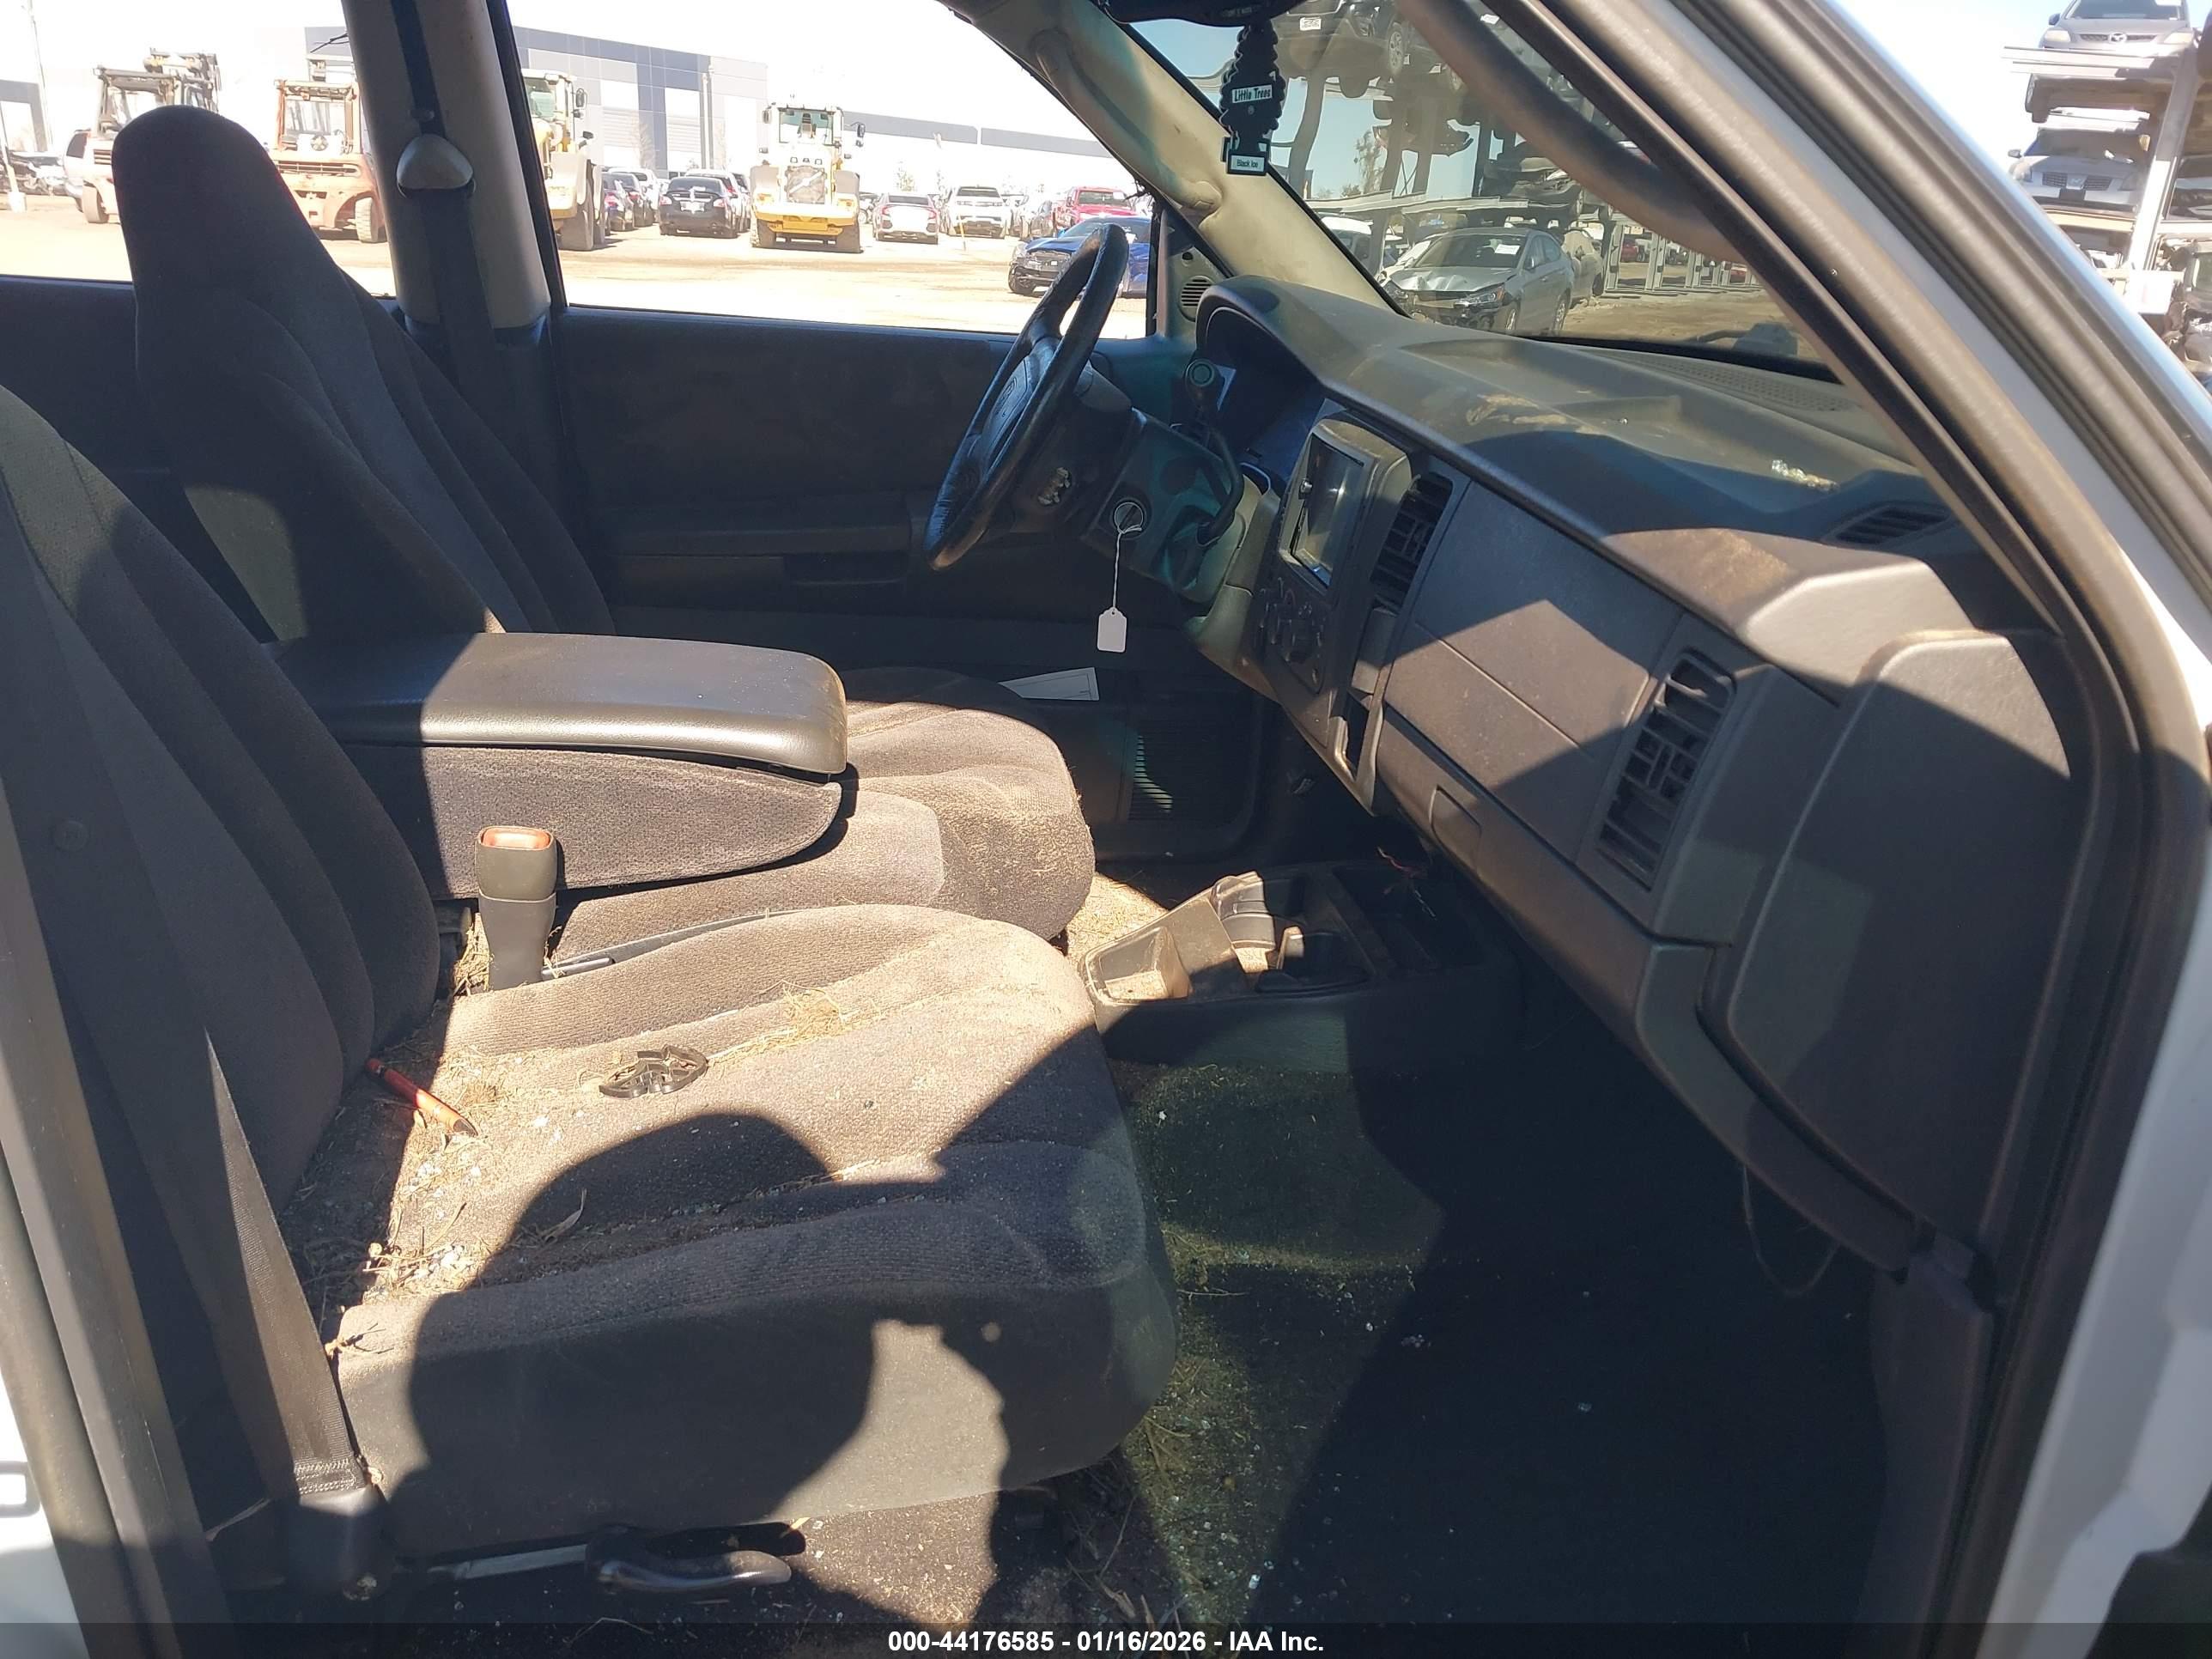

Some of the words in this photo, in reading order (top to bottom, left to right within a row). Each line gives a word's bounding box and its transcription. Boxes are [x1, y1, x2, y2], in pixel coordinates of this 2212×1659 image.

[1234, 88, 1252, 102] Little
[1254, 88, 1271, 100] Trees
[1237, 158, 1251, 167] Black
